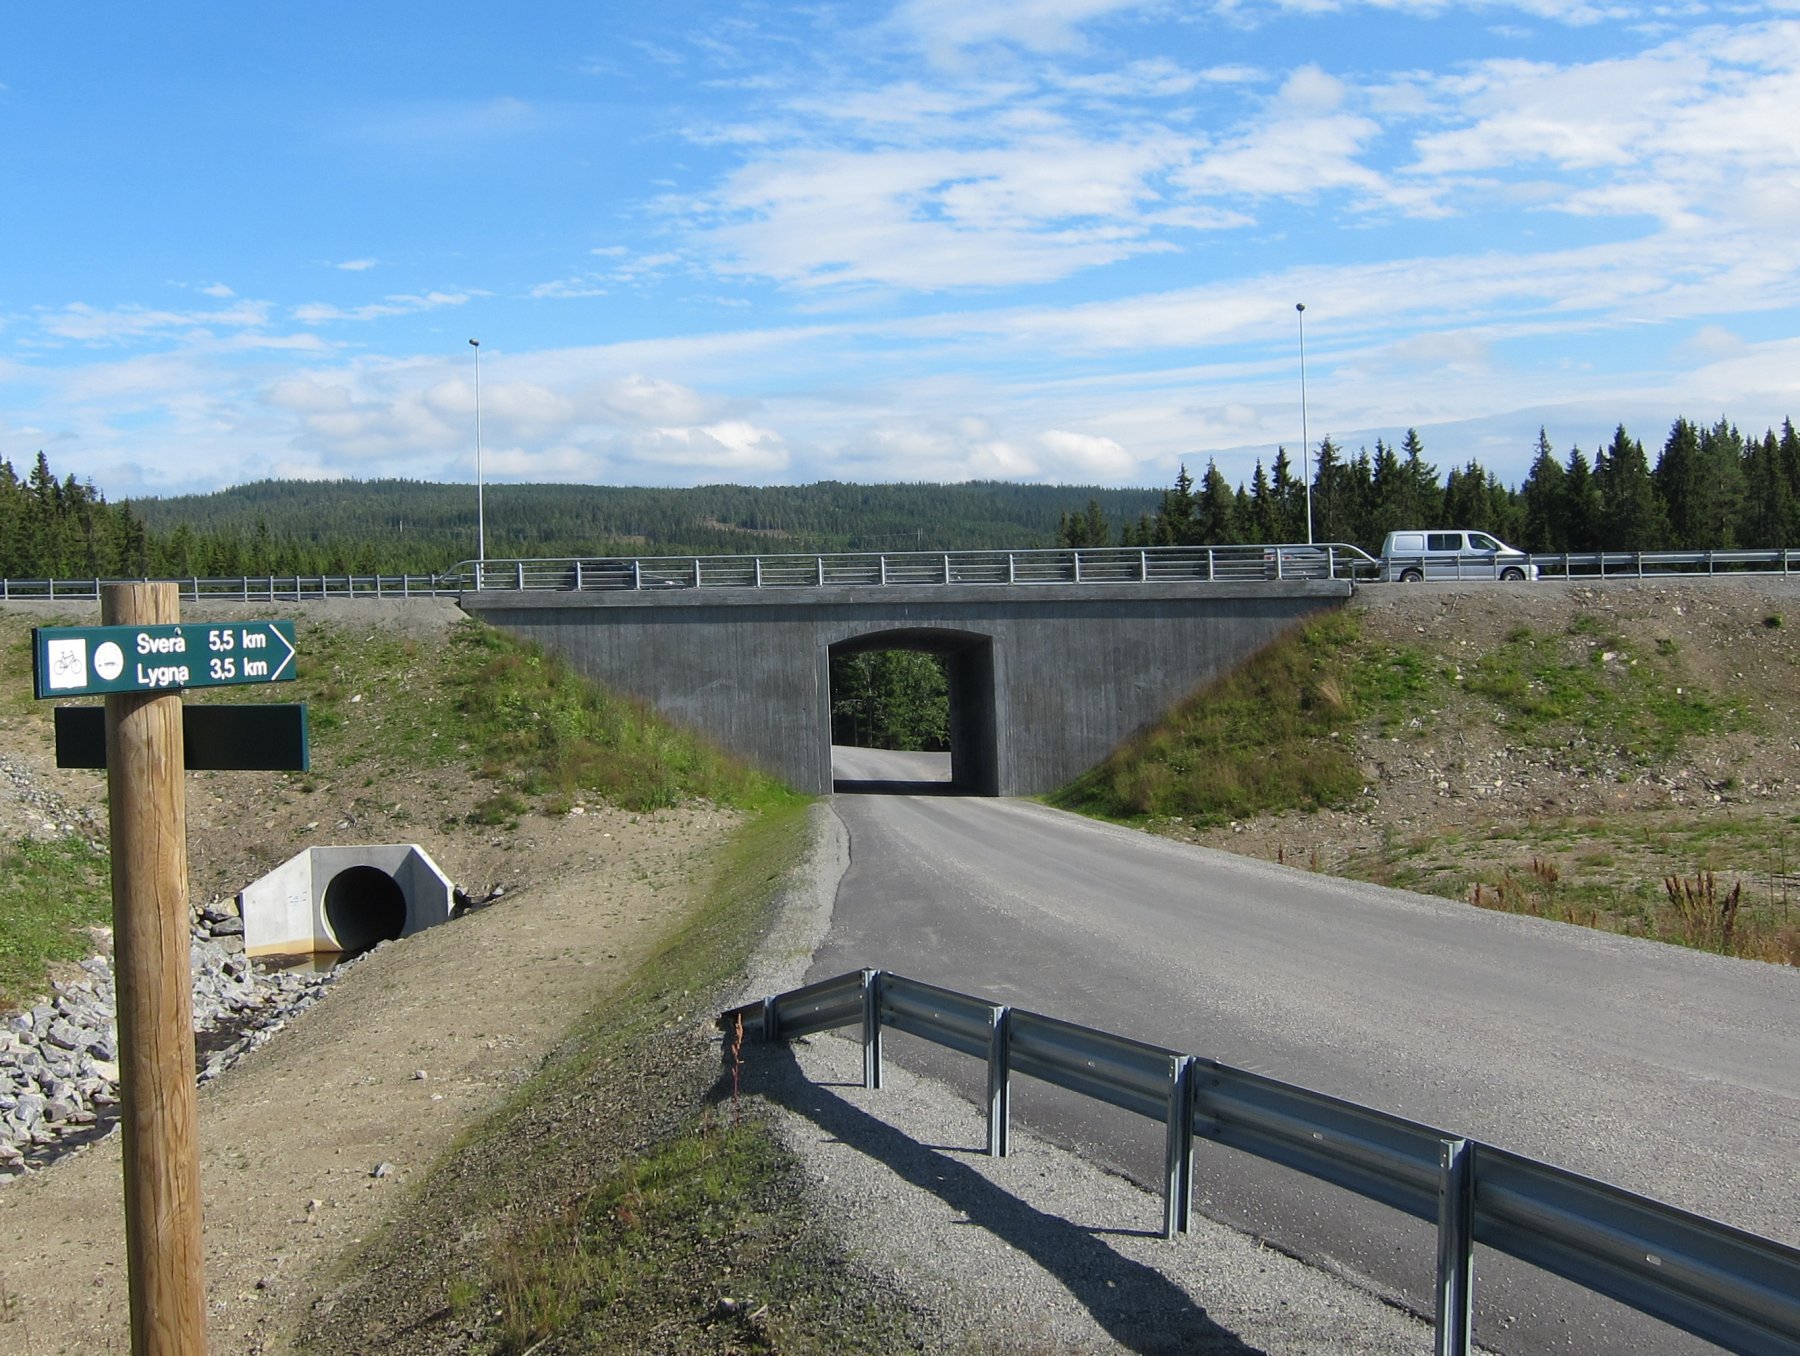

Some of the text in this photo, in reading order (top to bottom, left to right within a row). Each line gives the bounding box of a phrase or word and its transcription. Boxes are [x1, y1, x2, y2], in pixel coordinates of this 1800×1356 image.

[136, 629, 266, 655] Svera 5,5 km
[137, 656, 267, 687] Lygna 3,5 km
